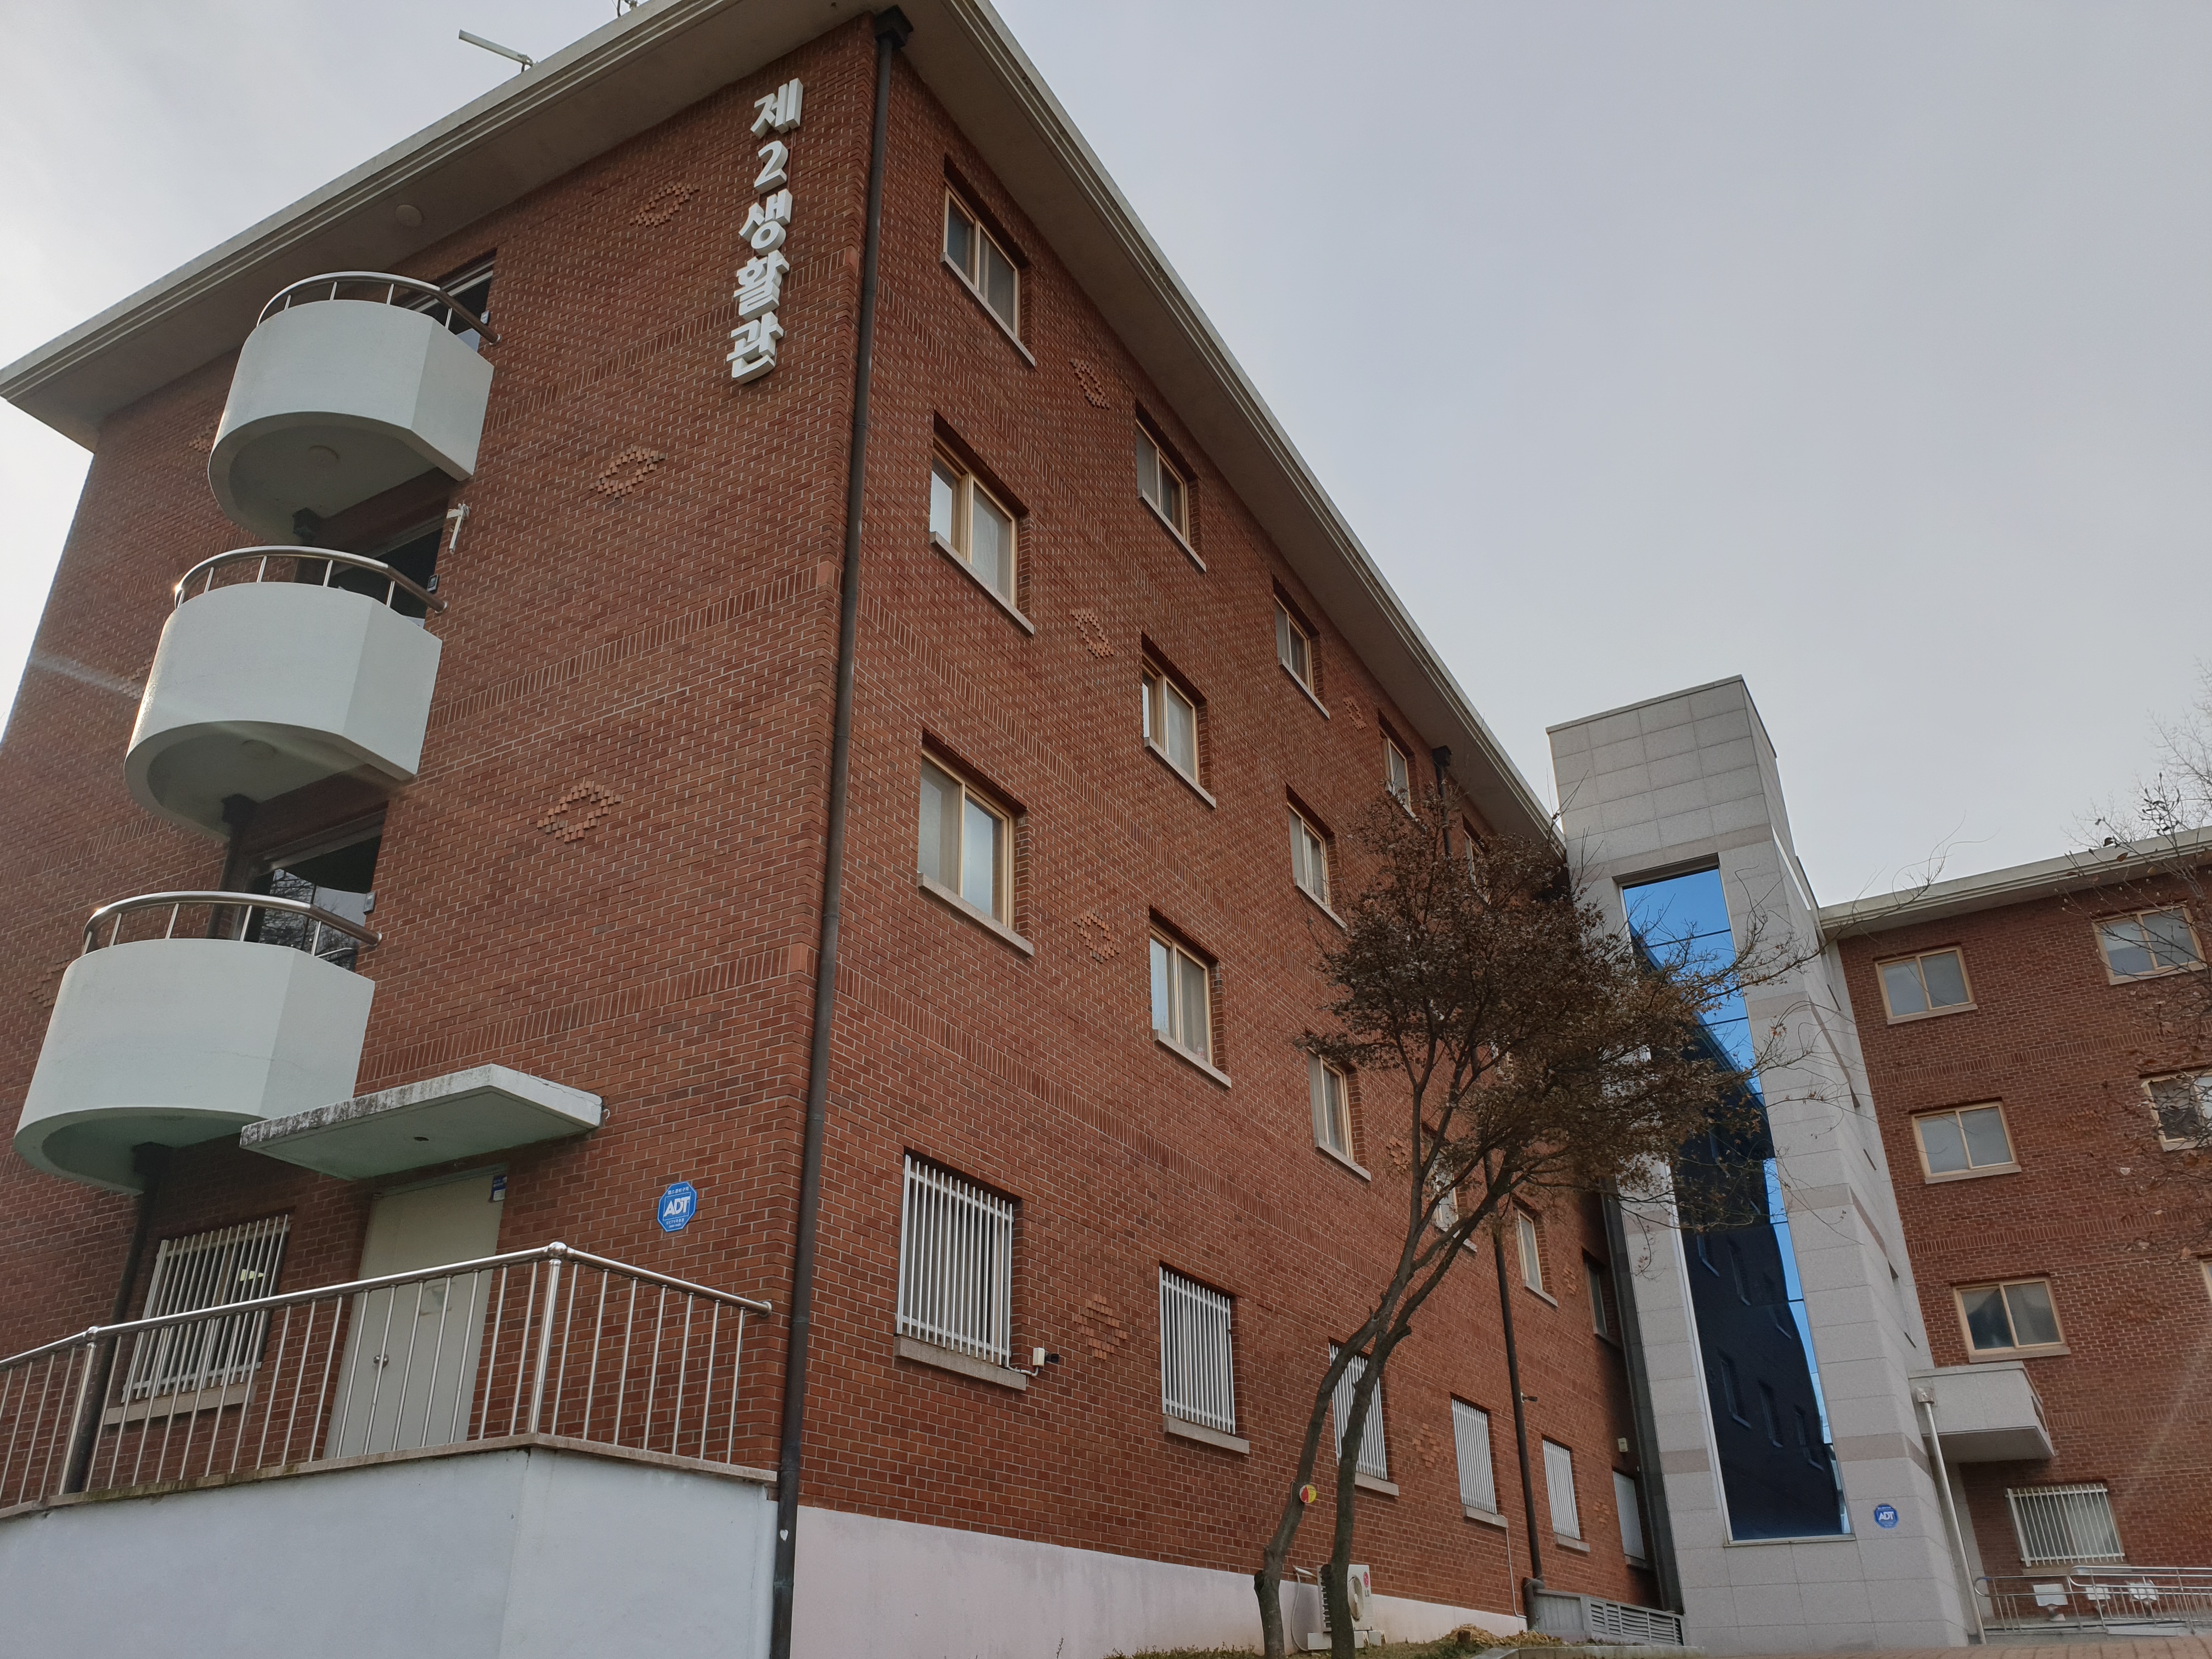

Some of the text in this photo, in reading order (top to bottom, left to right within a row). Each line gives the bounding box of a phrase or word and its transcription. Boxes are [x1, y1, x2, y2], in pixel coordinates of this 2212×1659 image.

[726, 77, 804, 383] 제2생활관
[663, 1196, 691, 1217] ADT
[1878, 1511, 1894, 1521] ADT
